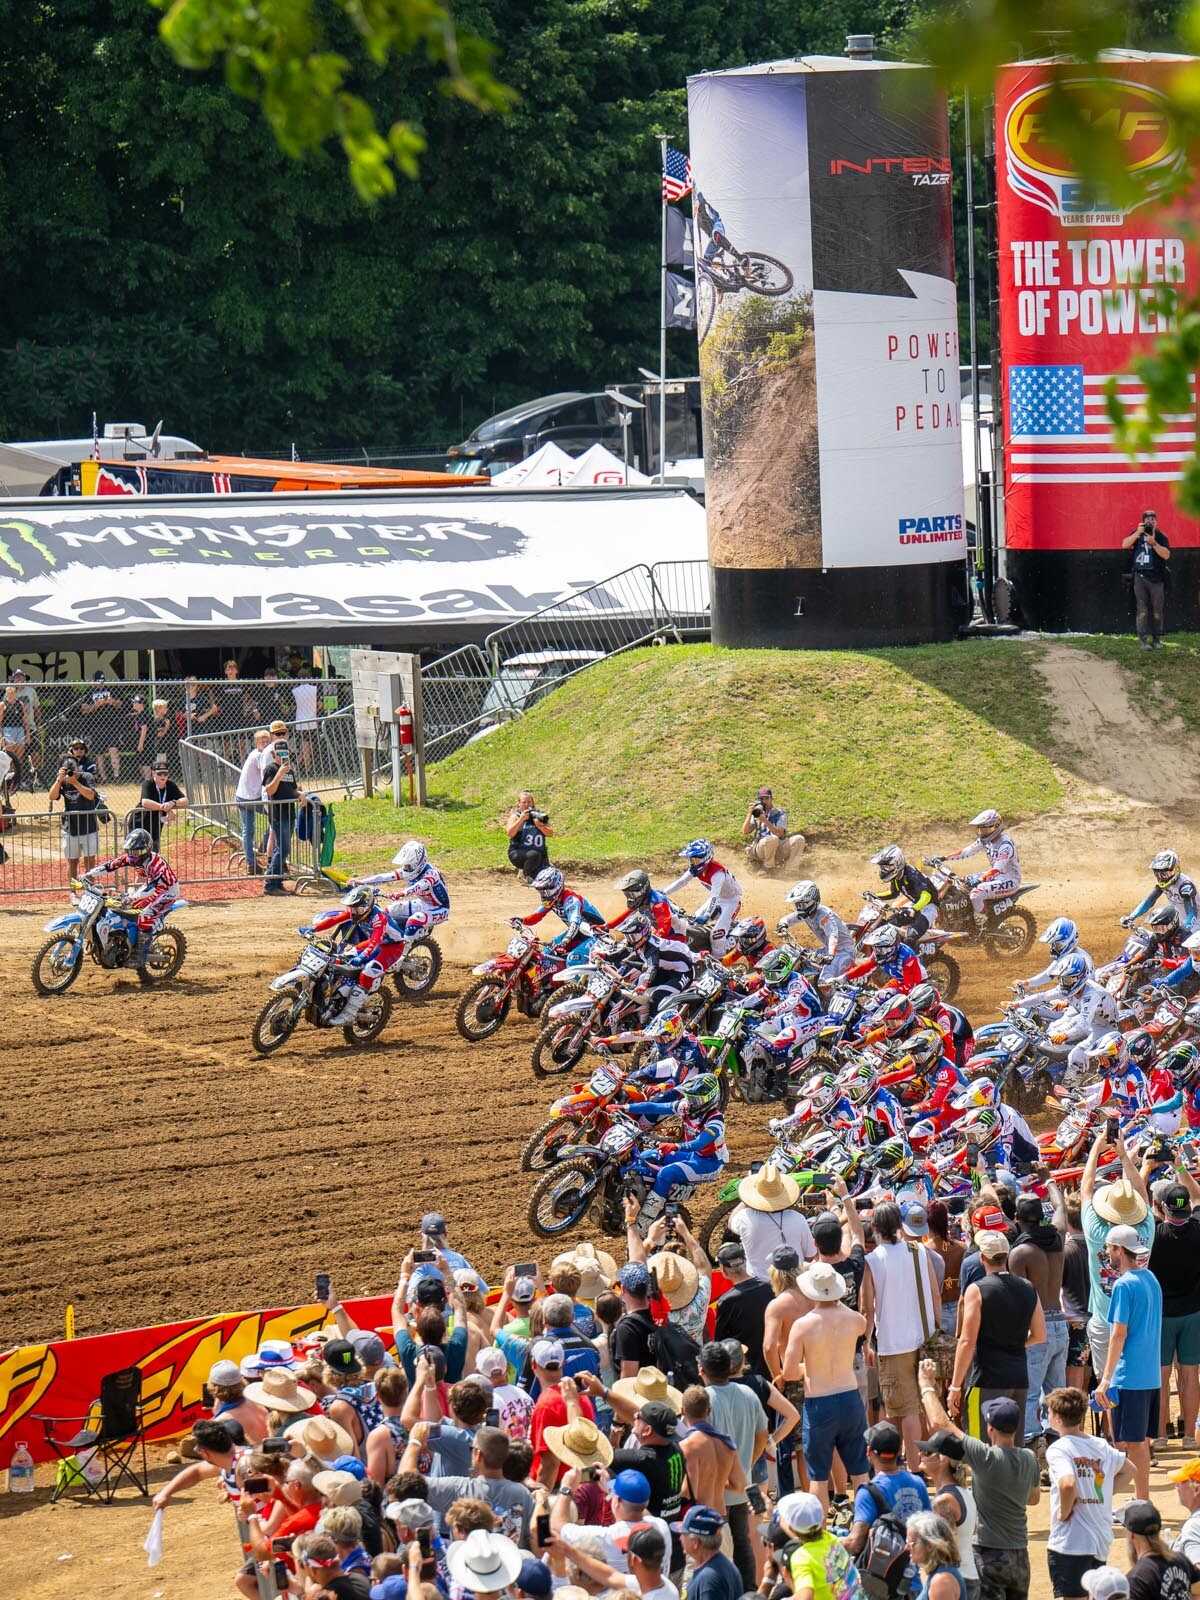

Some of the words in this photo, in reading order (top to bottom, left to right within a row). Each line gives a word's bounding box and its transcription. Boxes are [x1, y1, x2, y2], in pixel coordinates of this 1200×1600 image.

[1062, 214, 1085, 224] YEARS
[1086, 214, 1095, 224] OF
[1096, 214, 1121, 224] POWER
[1010, 240, 1061, 286] THE
[1066, 238, 1186, 285] TOWER
[1018, 289, 1050, 336] OF
[922, 368, 945, 394] TO
[896, 403, 959, 431] PEDAL
[899, 514, 962, 534] PARTS
[899, 530, 963, 545] UNLIMITED
[148, 546, 436, 561] ENERGY
[523, 833, 544, 848] 30
[993, 898, 1014, 916] 694
[1000, 1032, 1024, 1053] 41
[670, 1183, 694, 1201] 238
